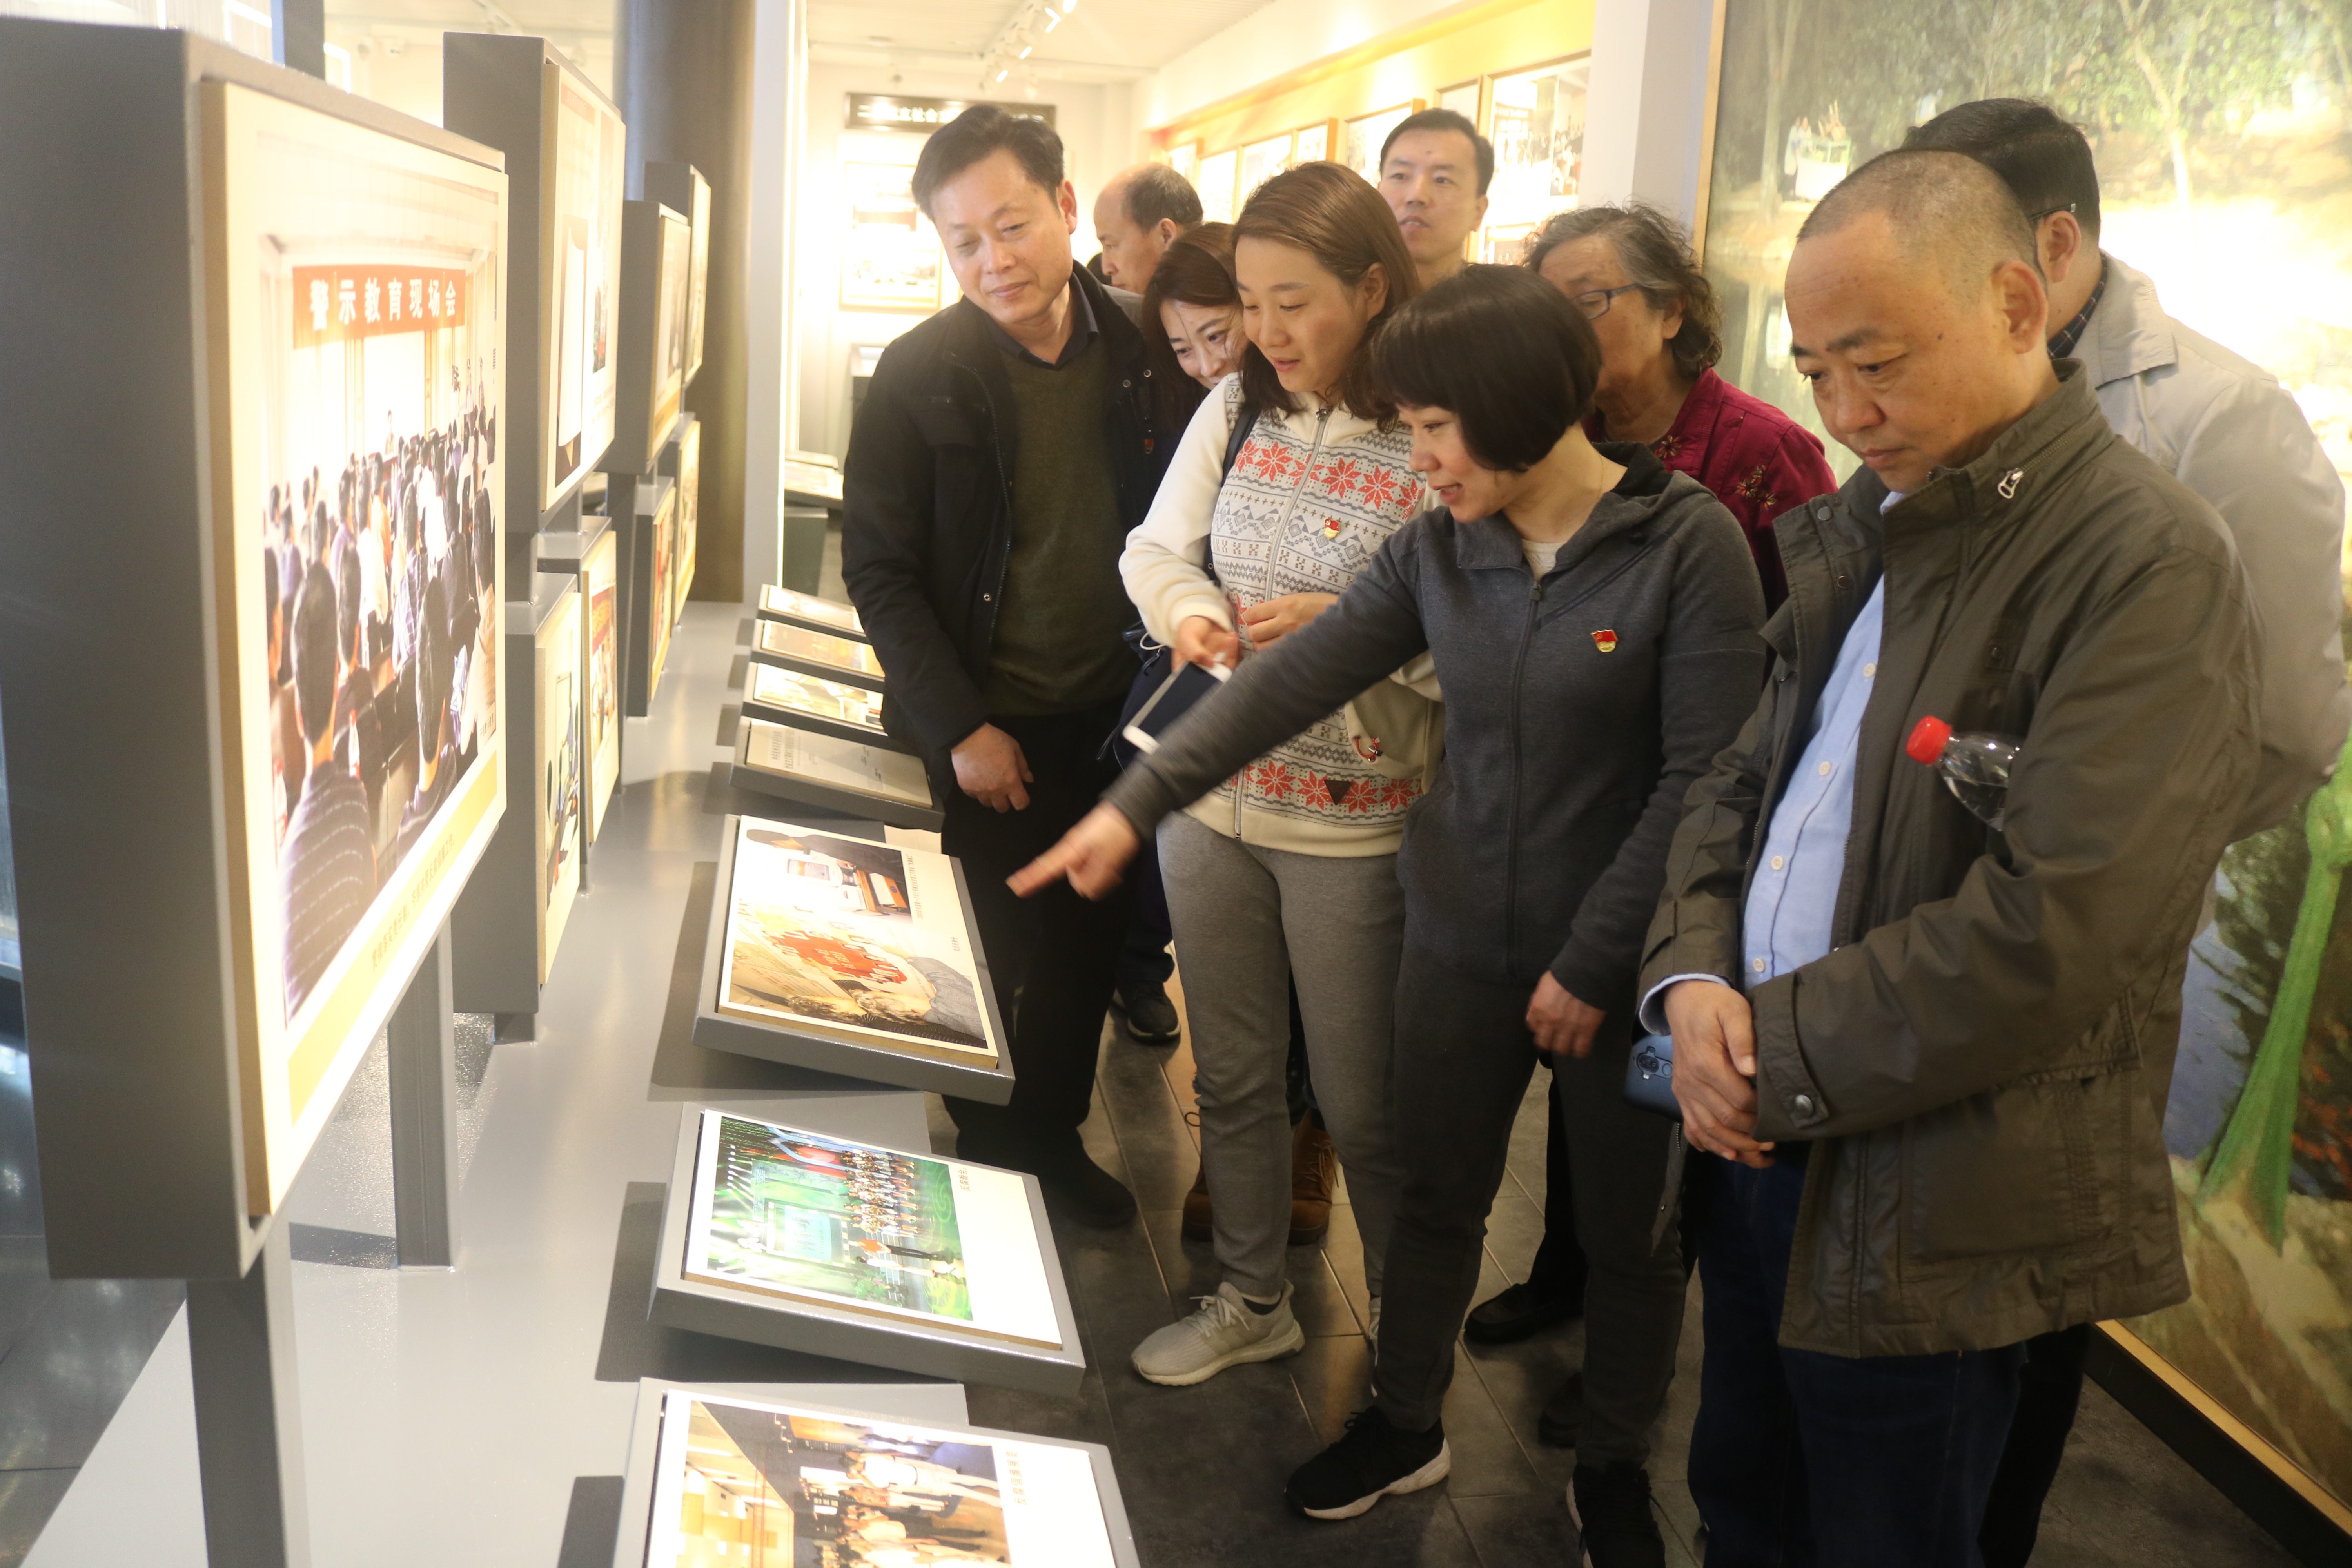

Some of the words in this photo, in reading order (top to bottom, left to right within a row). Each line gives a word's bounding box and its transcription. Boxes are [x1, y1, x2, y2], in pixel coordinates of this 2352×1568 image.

[310, 277, 456, 330] 警示教育现场会
